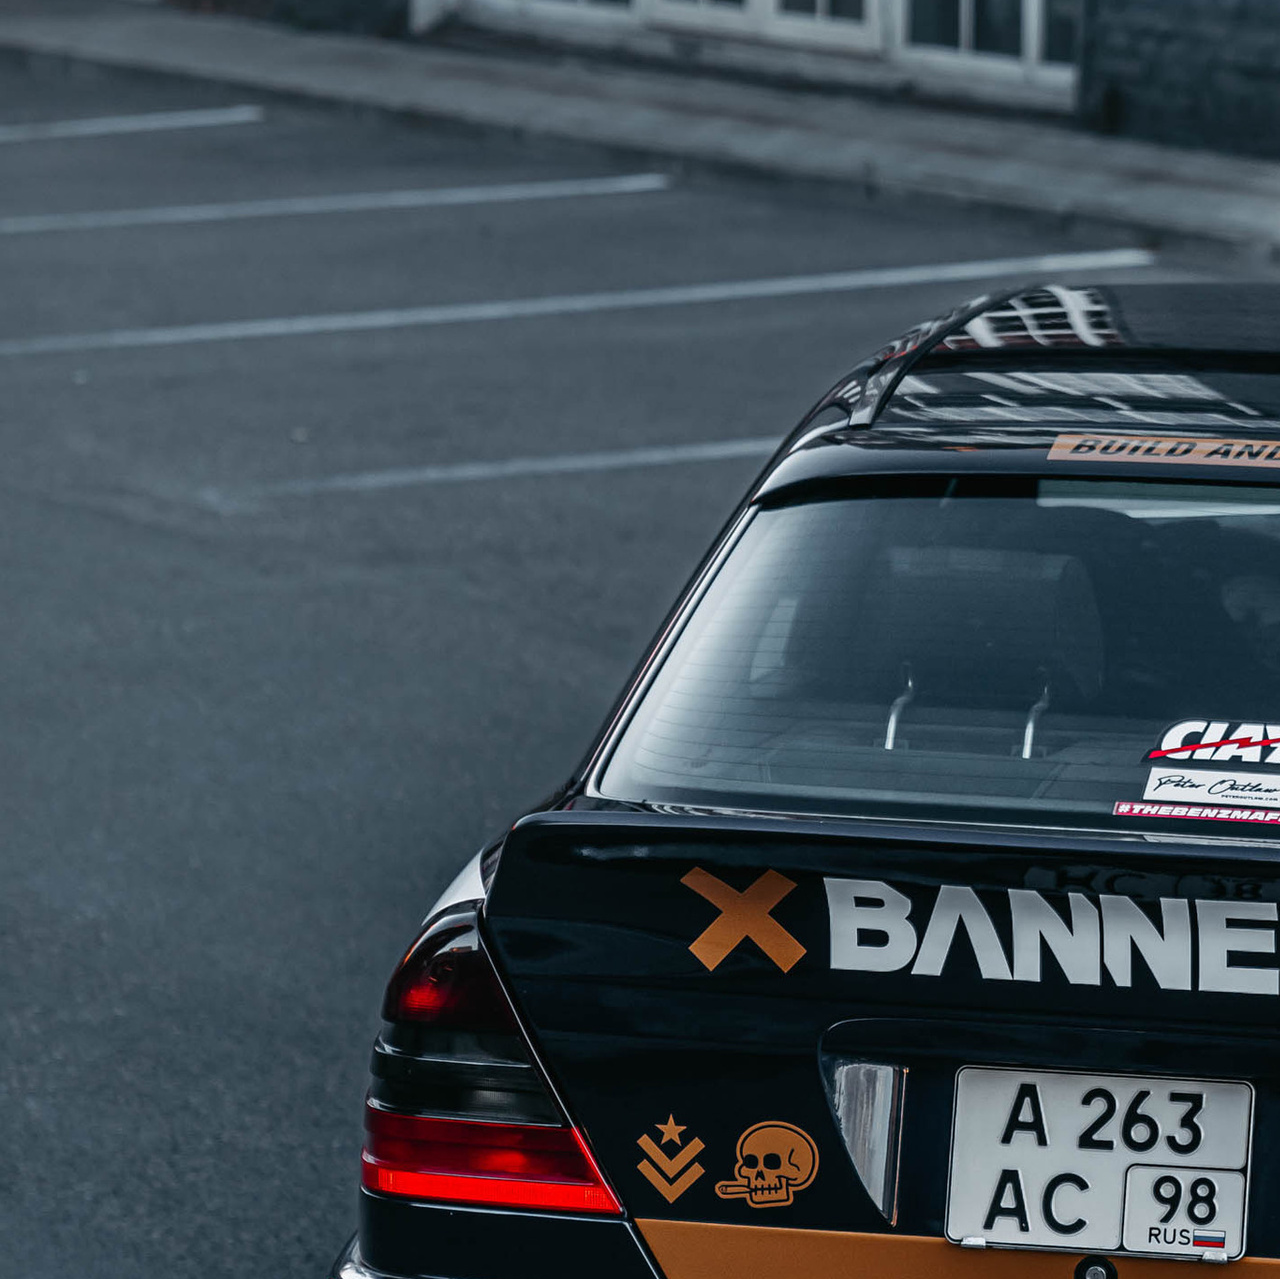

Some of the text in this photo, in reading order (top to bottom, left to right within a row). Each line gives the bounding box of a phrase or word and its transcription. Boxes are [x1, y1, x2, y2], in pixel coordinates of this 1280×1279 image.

[1069, 438, 1193, 458] BUILD
[1153, 775, 1206, 792] Peter
[1001, 1083, 1204, 1155] A 263
[983, 1169, 1090, 1235] AC
[1152, 1174, 1217, 1225] 98
[1148, 1226, 1191, 1246] RUS
